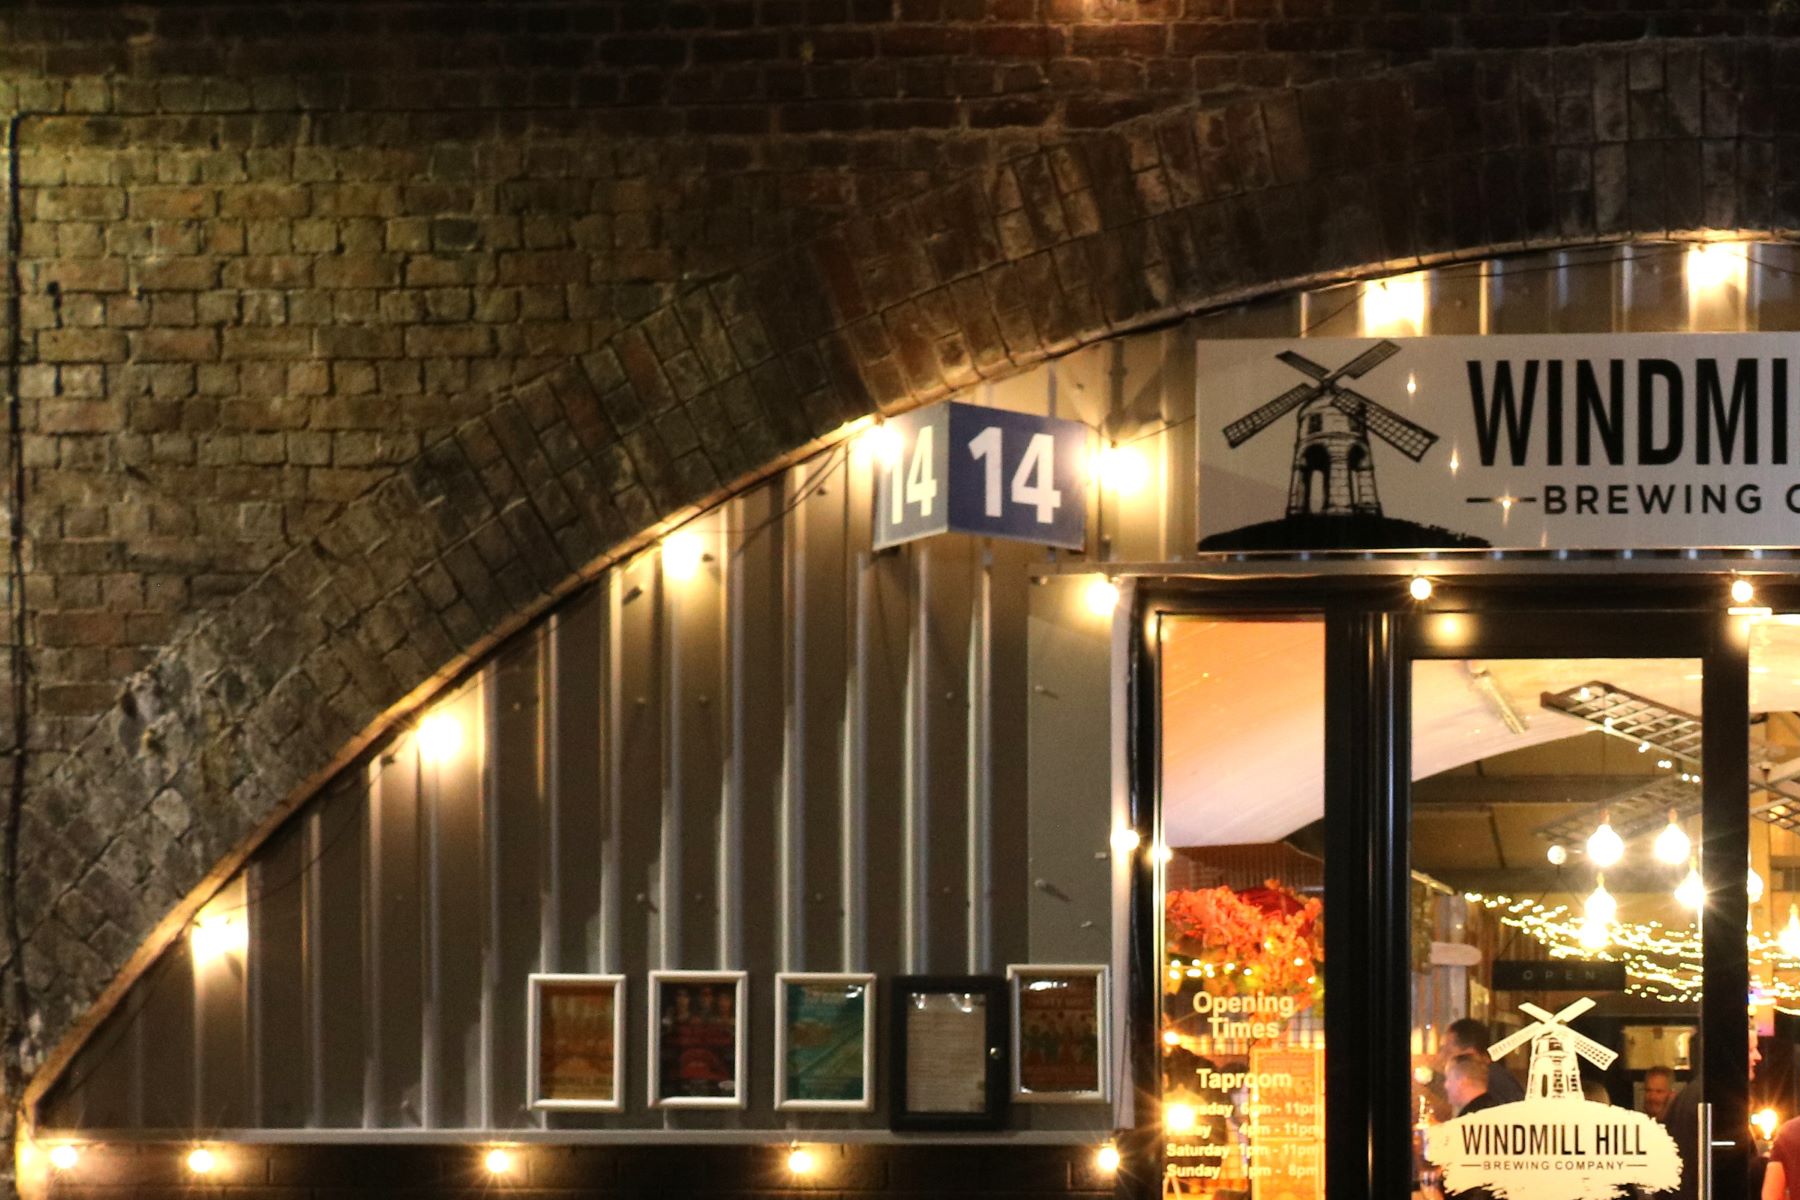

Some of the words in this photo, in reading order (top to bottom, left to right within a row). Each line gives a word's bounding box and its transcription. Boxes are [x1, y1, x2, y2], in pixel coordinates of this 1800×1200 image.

[888, 424, 938, 526] 14
[967, 425, 1062, 524] 14
[1543, 482, 1762, 516] BREWING
[1523, 970, 1595, 980] OPEN
[1192, 990, 1295, 1018] Opening
[1207, 1017, 1281, 1040] Times
[1196, 1067, 1293, 1093] Taproom
[1166, 1142, 1231, 1160] Saturday
[1461, 1124, 1586, 1156] WINDMILL
[1595, 1124, 1648, 1156] HILL
[1166, 1163, 1221, 1180] Sunday
[1483, 1160, 1551, 1171] BREWING
[1554, 1160, 1625, 1171] COMPANY
